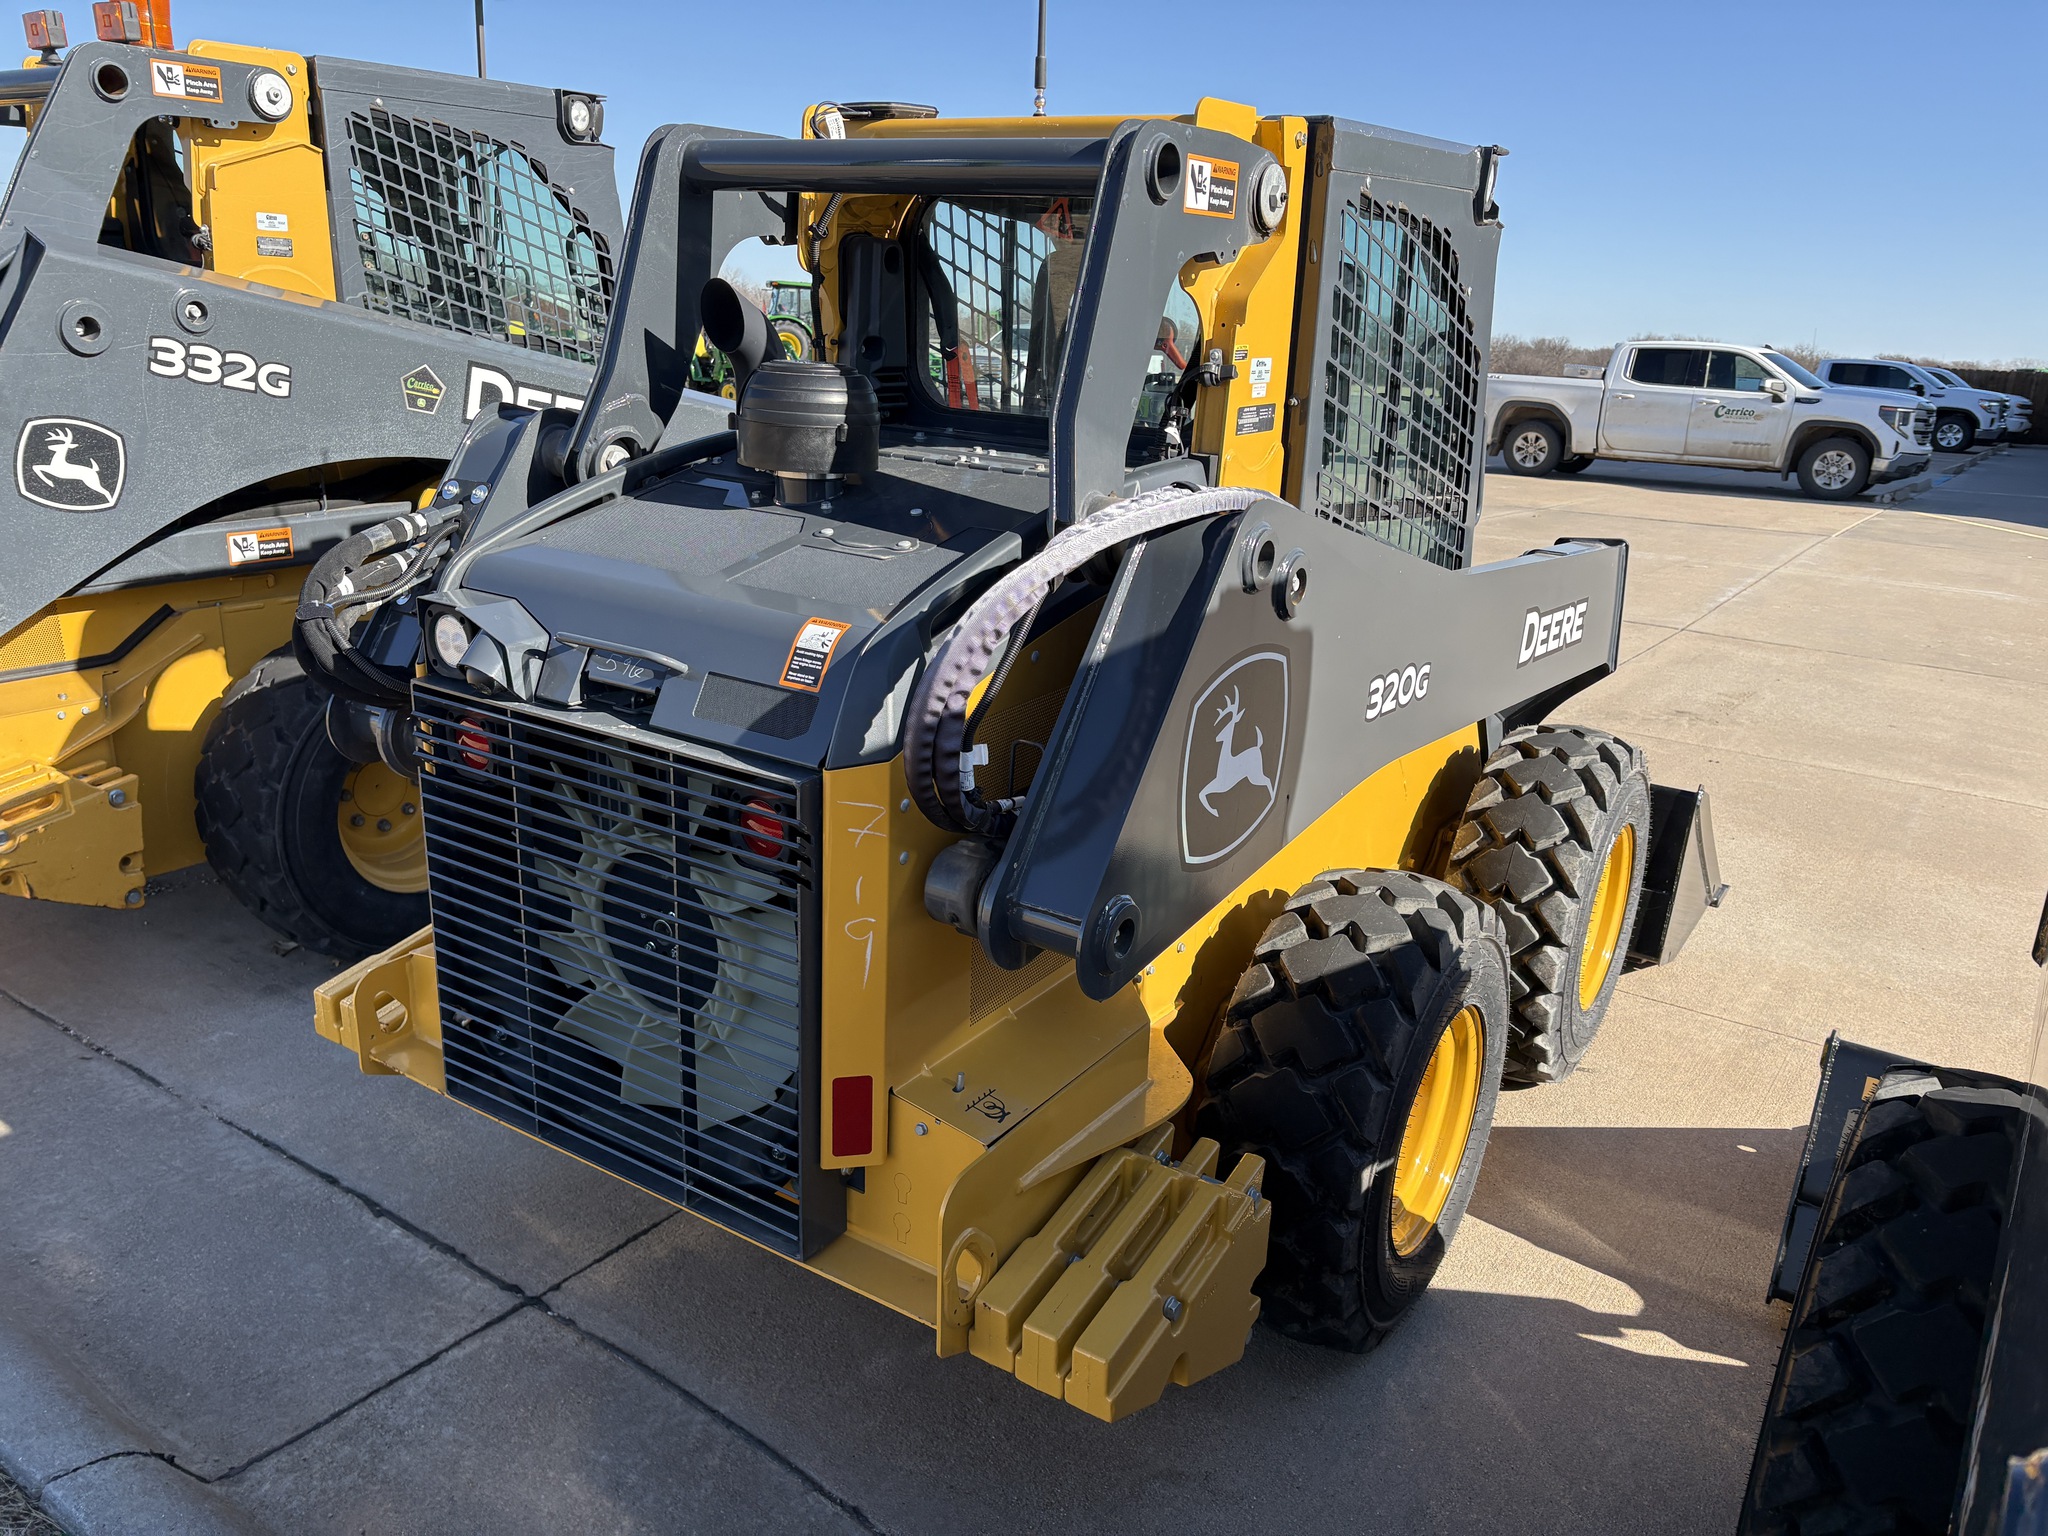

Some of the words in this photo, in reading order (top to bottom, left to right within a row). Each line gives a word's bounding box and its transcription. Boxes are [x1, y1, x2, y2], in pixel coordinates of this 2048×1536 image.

[190, 66, 217, 76] WARNING
[186, 78, 203, 87] Pinch
[203, 80, 218, 89] Area
[186, 86, 200, 94] Keep
[199, 87, 214, 96] Away
[1216, 165, 1237, 176] WARNING
[1210, 184, 1224, 195] Pinch
[1223, 186, 1234, 196] Area
[1209, 196, 1220, 207] Keep
[1219, 197, 1230, 208] Away
[148, 336, 292, 398] 332G
[406, 376, 435, 390] Carrico
[1714, 404, 1755, 418] Carrico
[264, 530, 289, 538] WARNING
[260, 542, 276, 550] Pinch
[275, 541, 289, 549] Area
[818, 619, 848, 629] WARNING
[1516, 598, 1589, 668] DEERE
[1364, 662, 1431, 722] 320G
